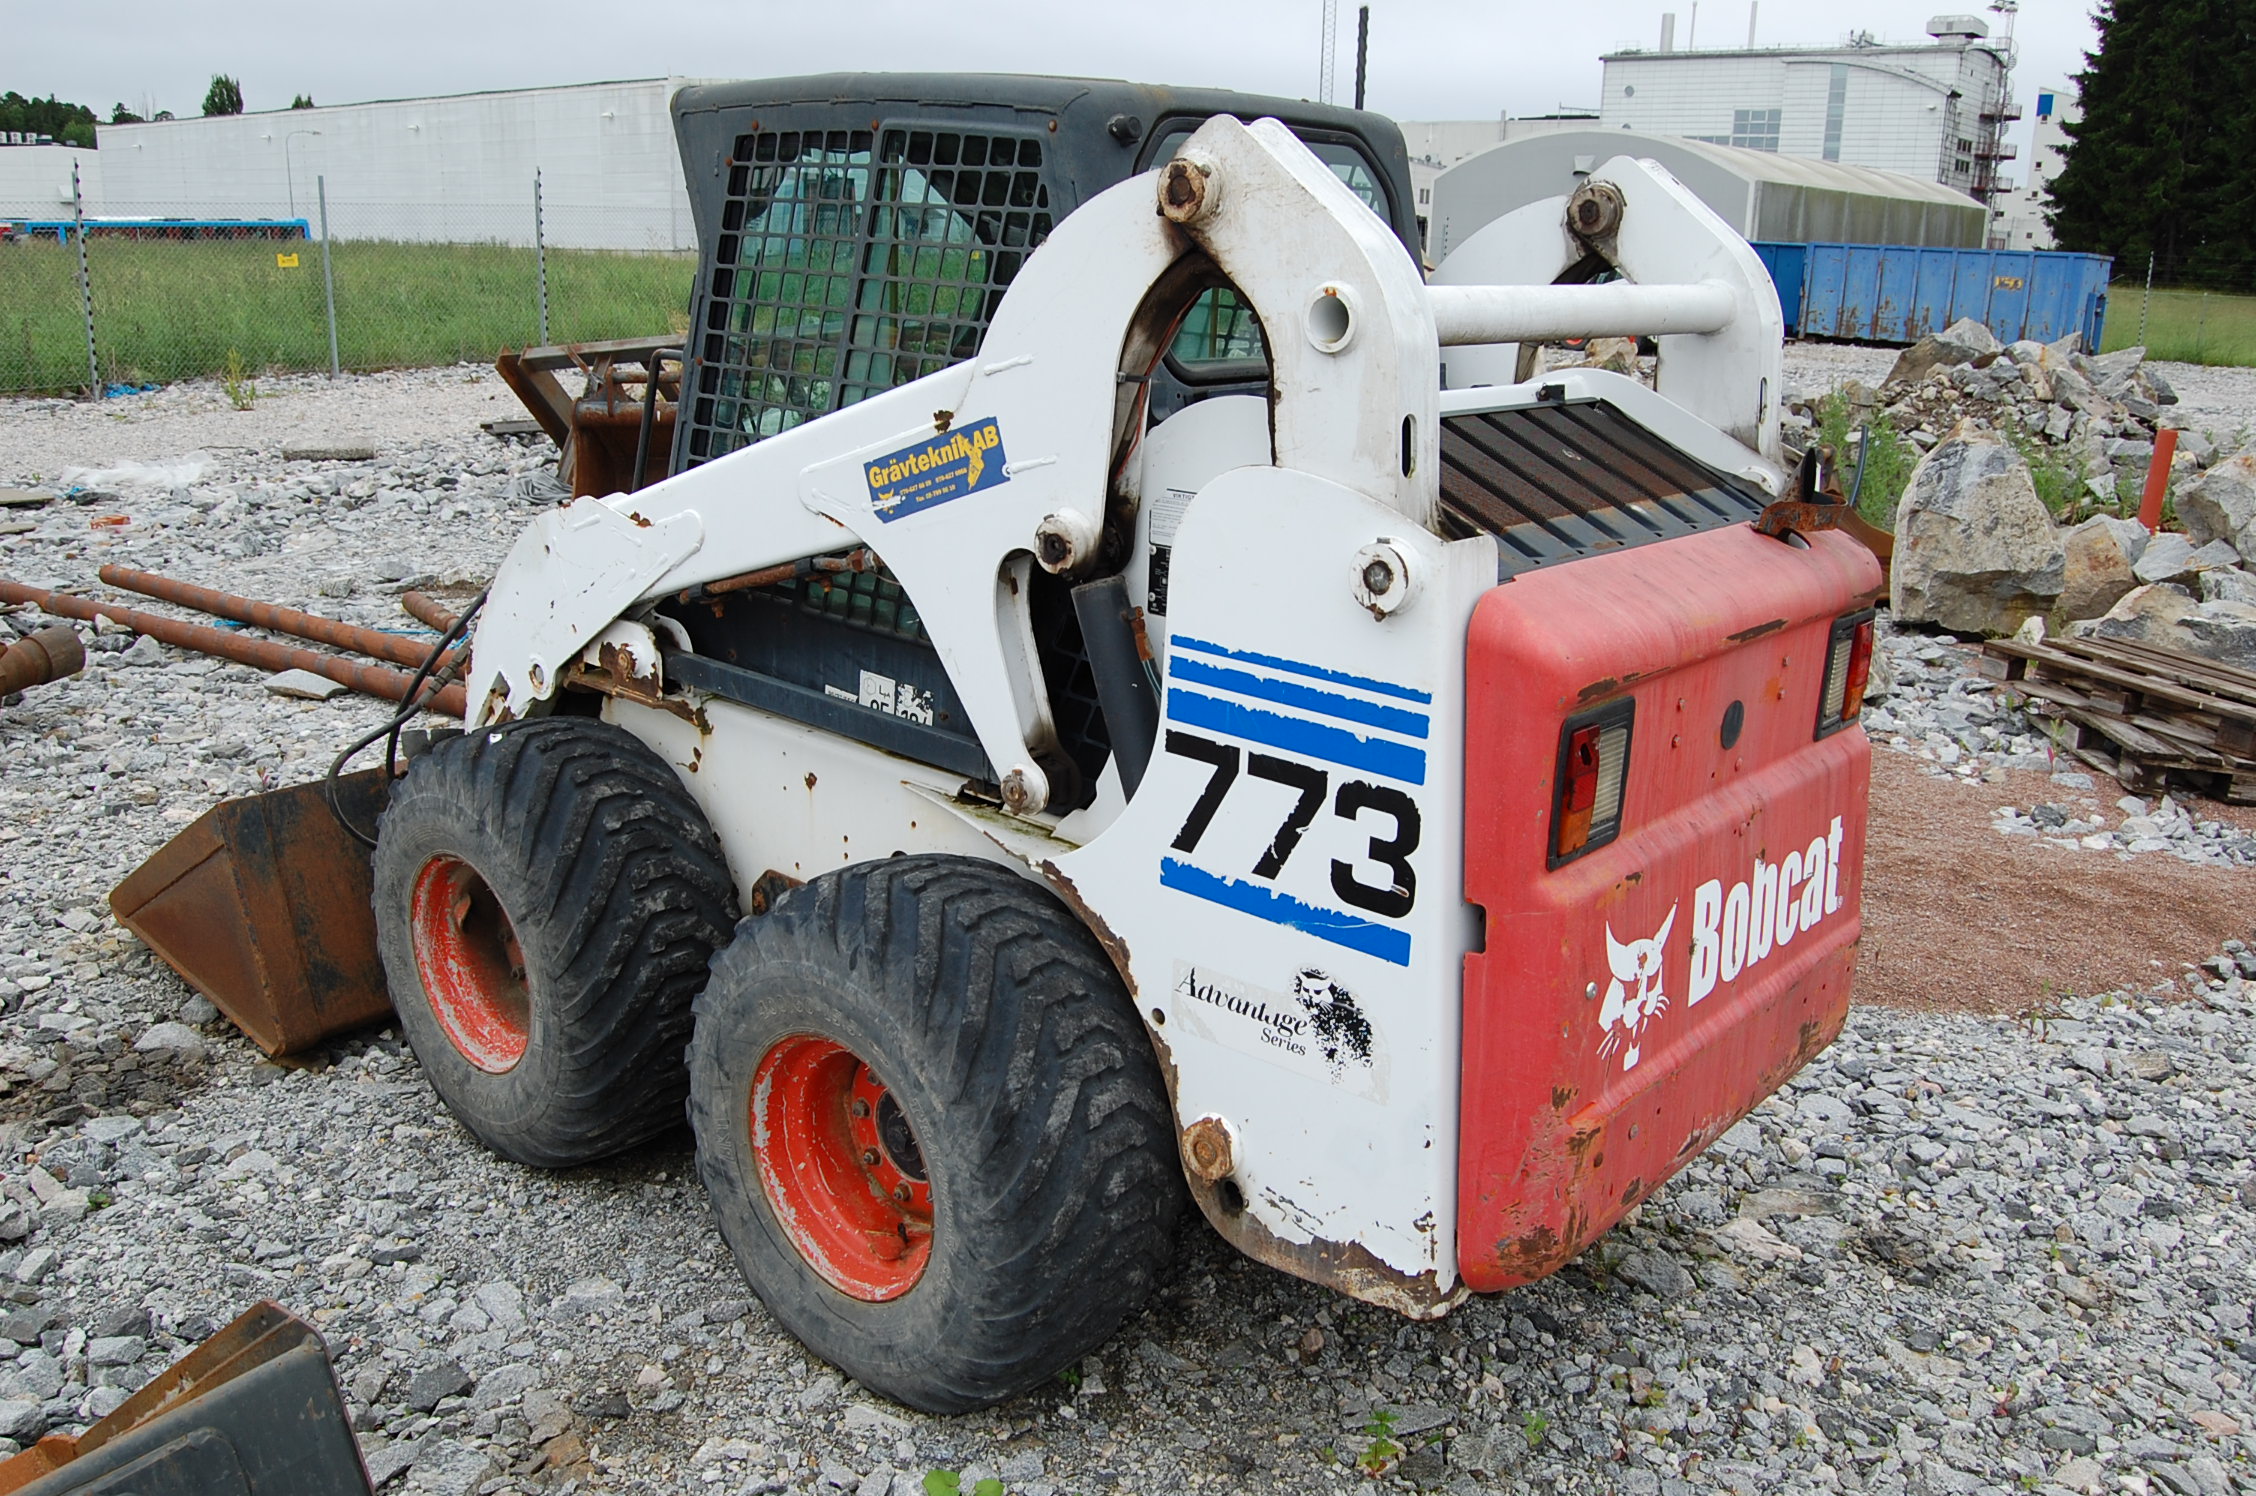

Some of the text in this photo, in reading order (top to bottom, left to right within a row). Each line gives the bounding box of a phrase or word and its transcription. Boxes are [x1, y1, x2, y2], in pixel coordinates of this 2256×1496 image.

[868, 424, 1000, 489] Grävteknik AB
[1165, 728, 1421, 919] 773
[1687, 815, 1843, 1008] Bobcat
[1174, 966, 1308, 1038] Advantage
[1260, 1027, 1307, 1056] Series
